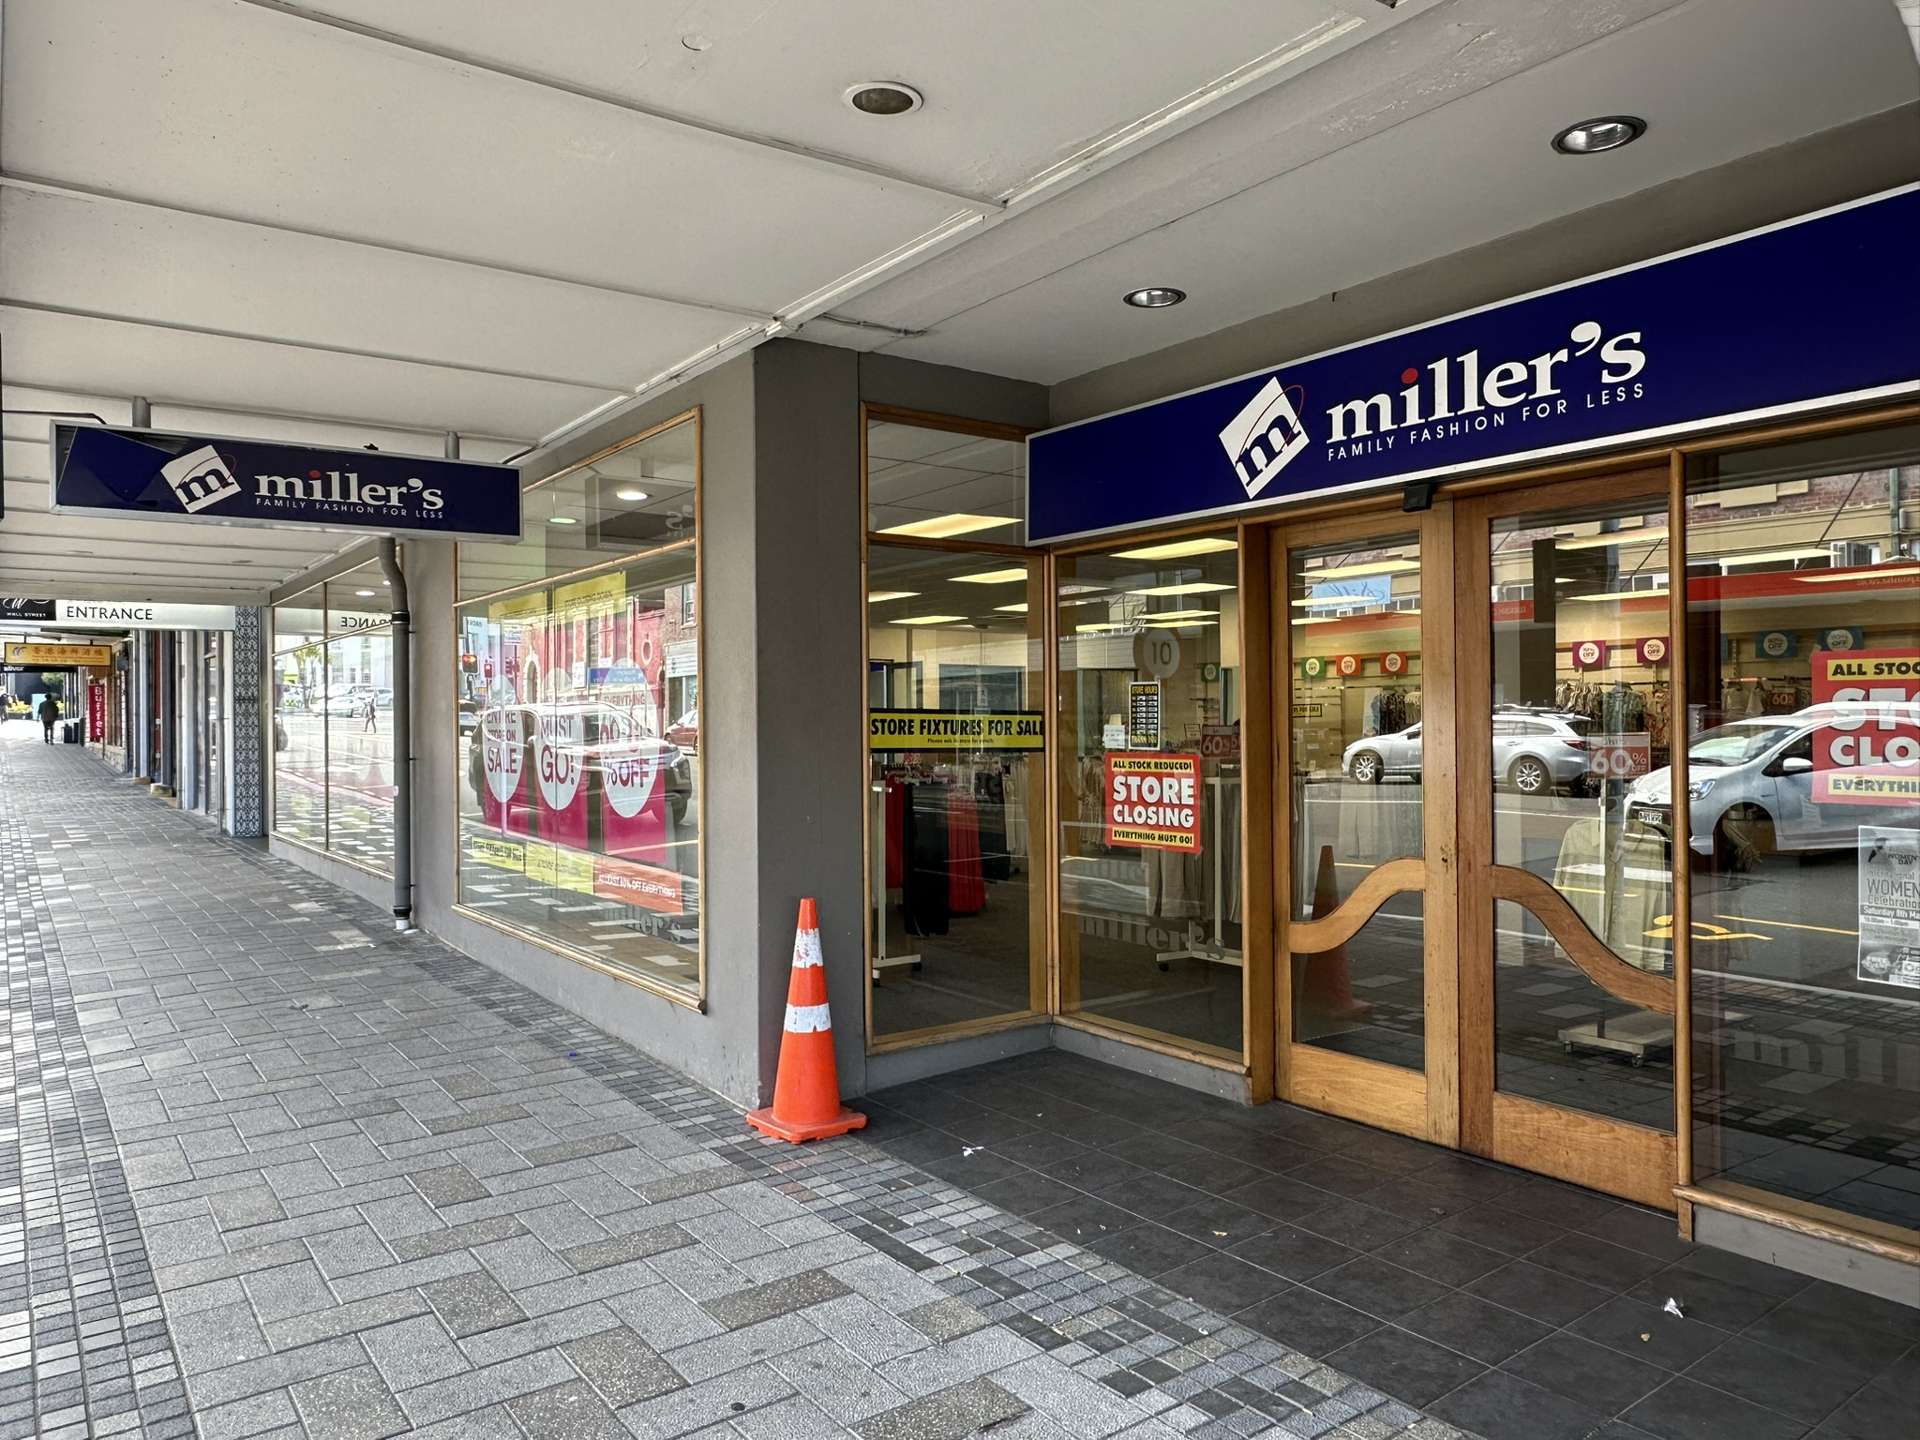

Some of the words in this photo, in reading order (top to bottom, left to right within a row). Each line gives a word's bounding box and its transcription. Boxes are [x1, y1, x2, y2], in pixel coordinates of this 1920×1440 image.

[1325, 321, 1646, 444] miller's
[1328, 435, 1395, 461] FAMILY
[1411, 412, 1505, 444] FASHION
[1522, 399, 1567, 421] FOR
[1586, 383, 1645, 408] LESS
[254, 470, 444, 510] miller's
[256, 498, 306, 509] FAMILY
[316, 502, 374, 514] FASHION
[383, 507, 407, 517] FOR
[416, 510, 443, 519] LESS
[66, 606, 153, 620] ENTRANCE
[1832, 663, 1867, 676] ALL
[541, 714, 574, 739] MUST
[871, 718, 914, 736] STORE
[919, 719, 982, 736] FIXTURES
[988, 719, 1013, 736] FOR
[541, 744, 575, 786] GO!
[1112, 760, 1126, 770] ALL
[1128, 761, 1151, 771] STOCK
[1153, 761, 1193, 772] REDUCED!
[1112, 776, 1195, 805] STORE
[1832, 778, 1920, 793] EVERYTHI
[1112, 804, 1195, 829] CLOSING
[1113, 829, 1156, 842] EVERYTHING
[1157, 832, 1176, 843] MUST
[1178, 834, 1193, 845] GO!
